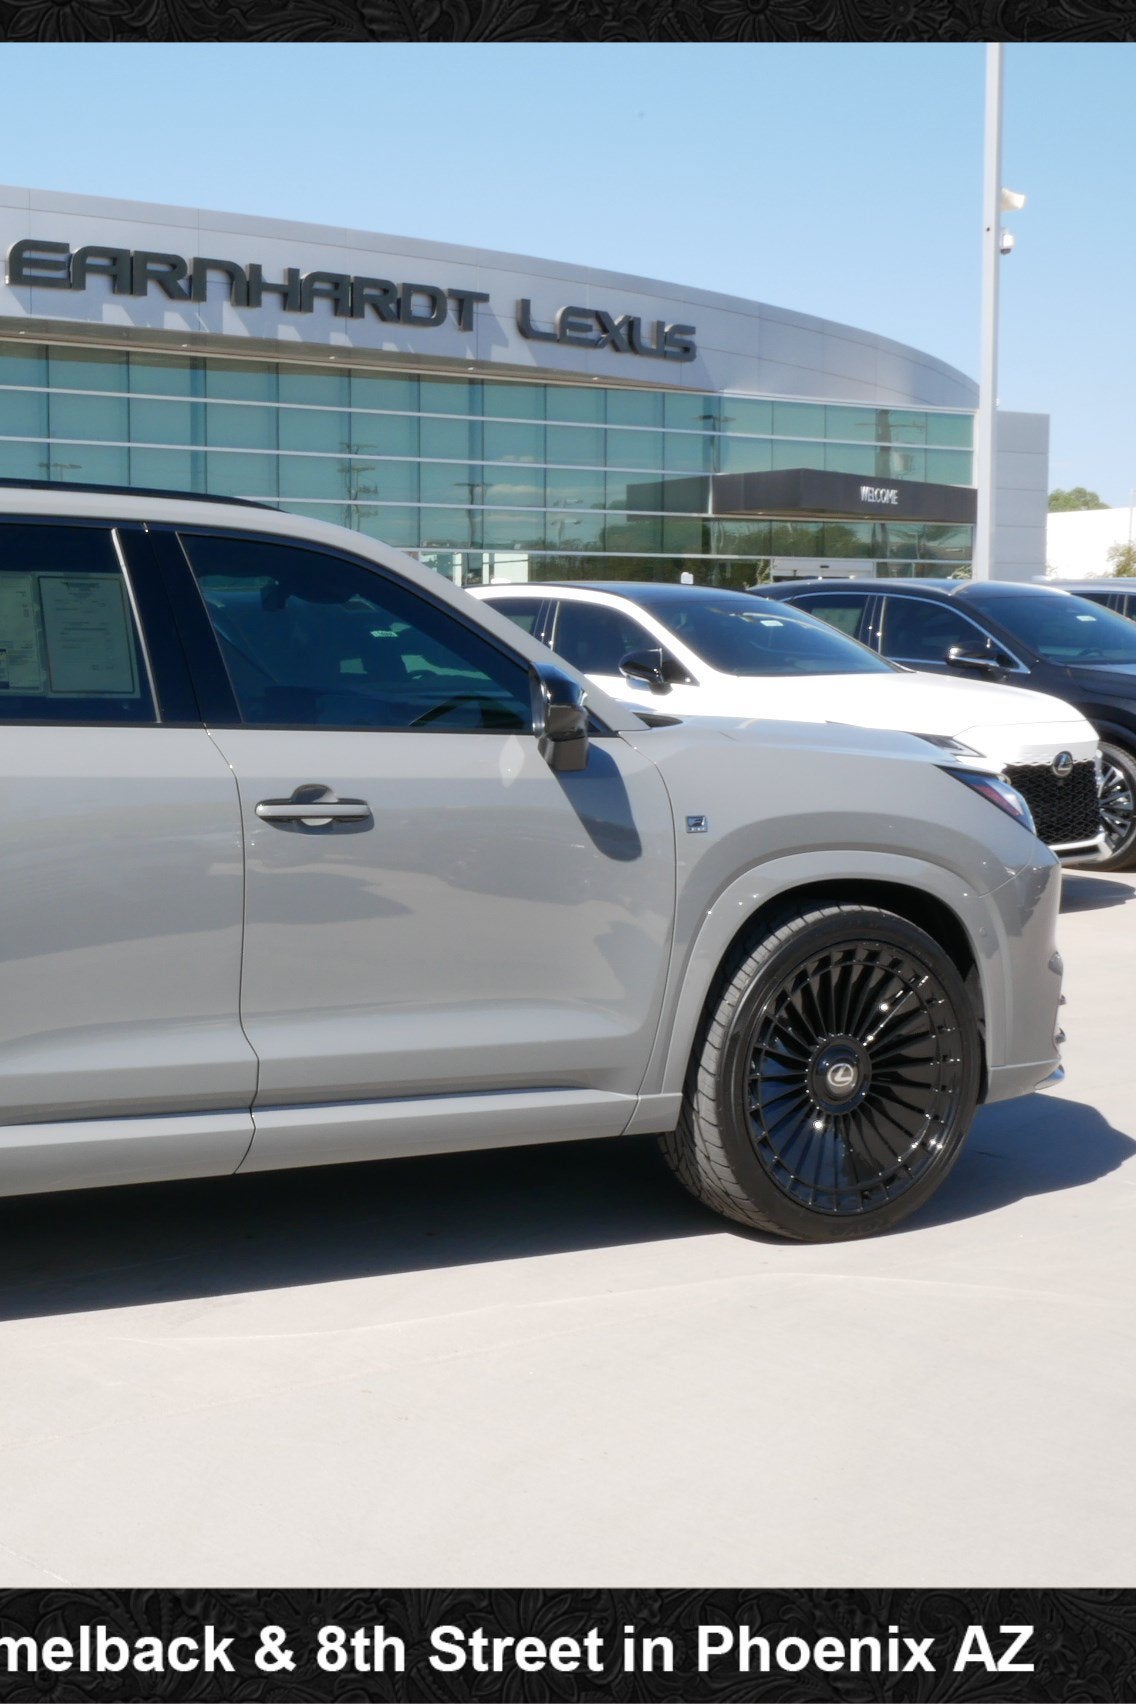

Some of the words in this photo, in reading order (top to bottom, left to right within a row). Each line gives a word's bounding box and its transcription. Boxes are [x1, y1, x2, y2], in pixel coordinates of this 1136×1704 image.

[5, 239, 490, 332] EARNHARDT
[516, 298, 697, 363] LEXUS
[860, 485, 899, 505] WELCOME
